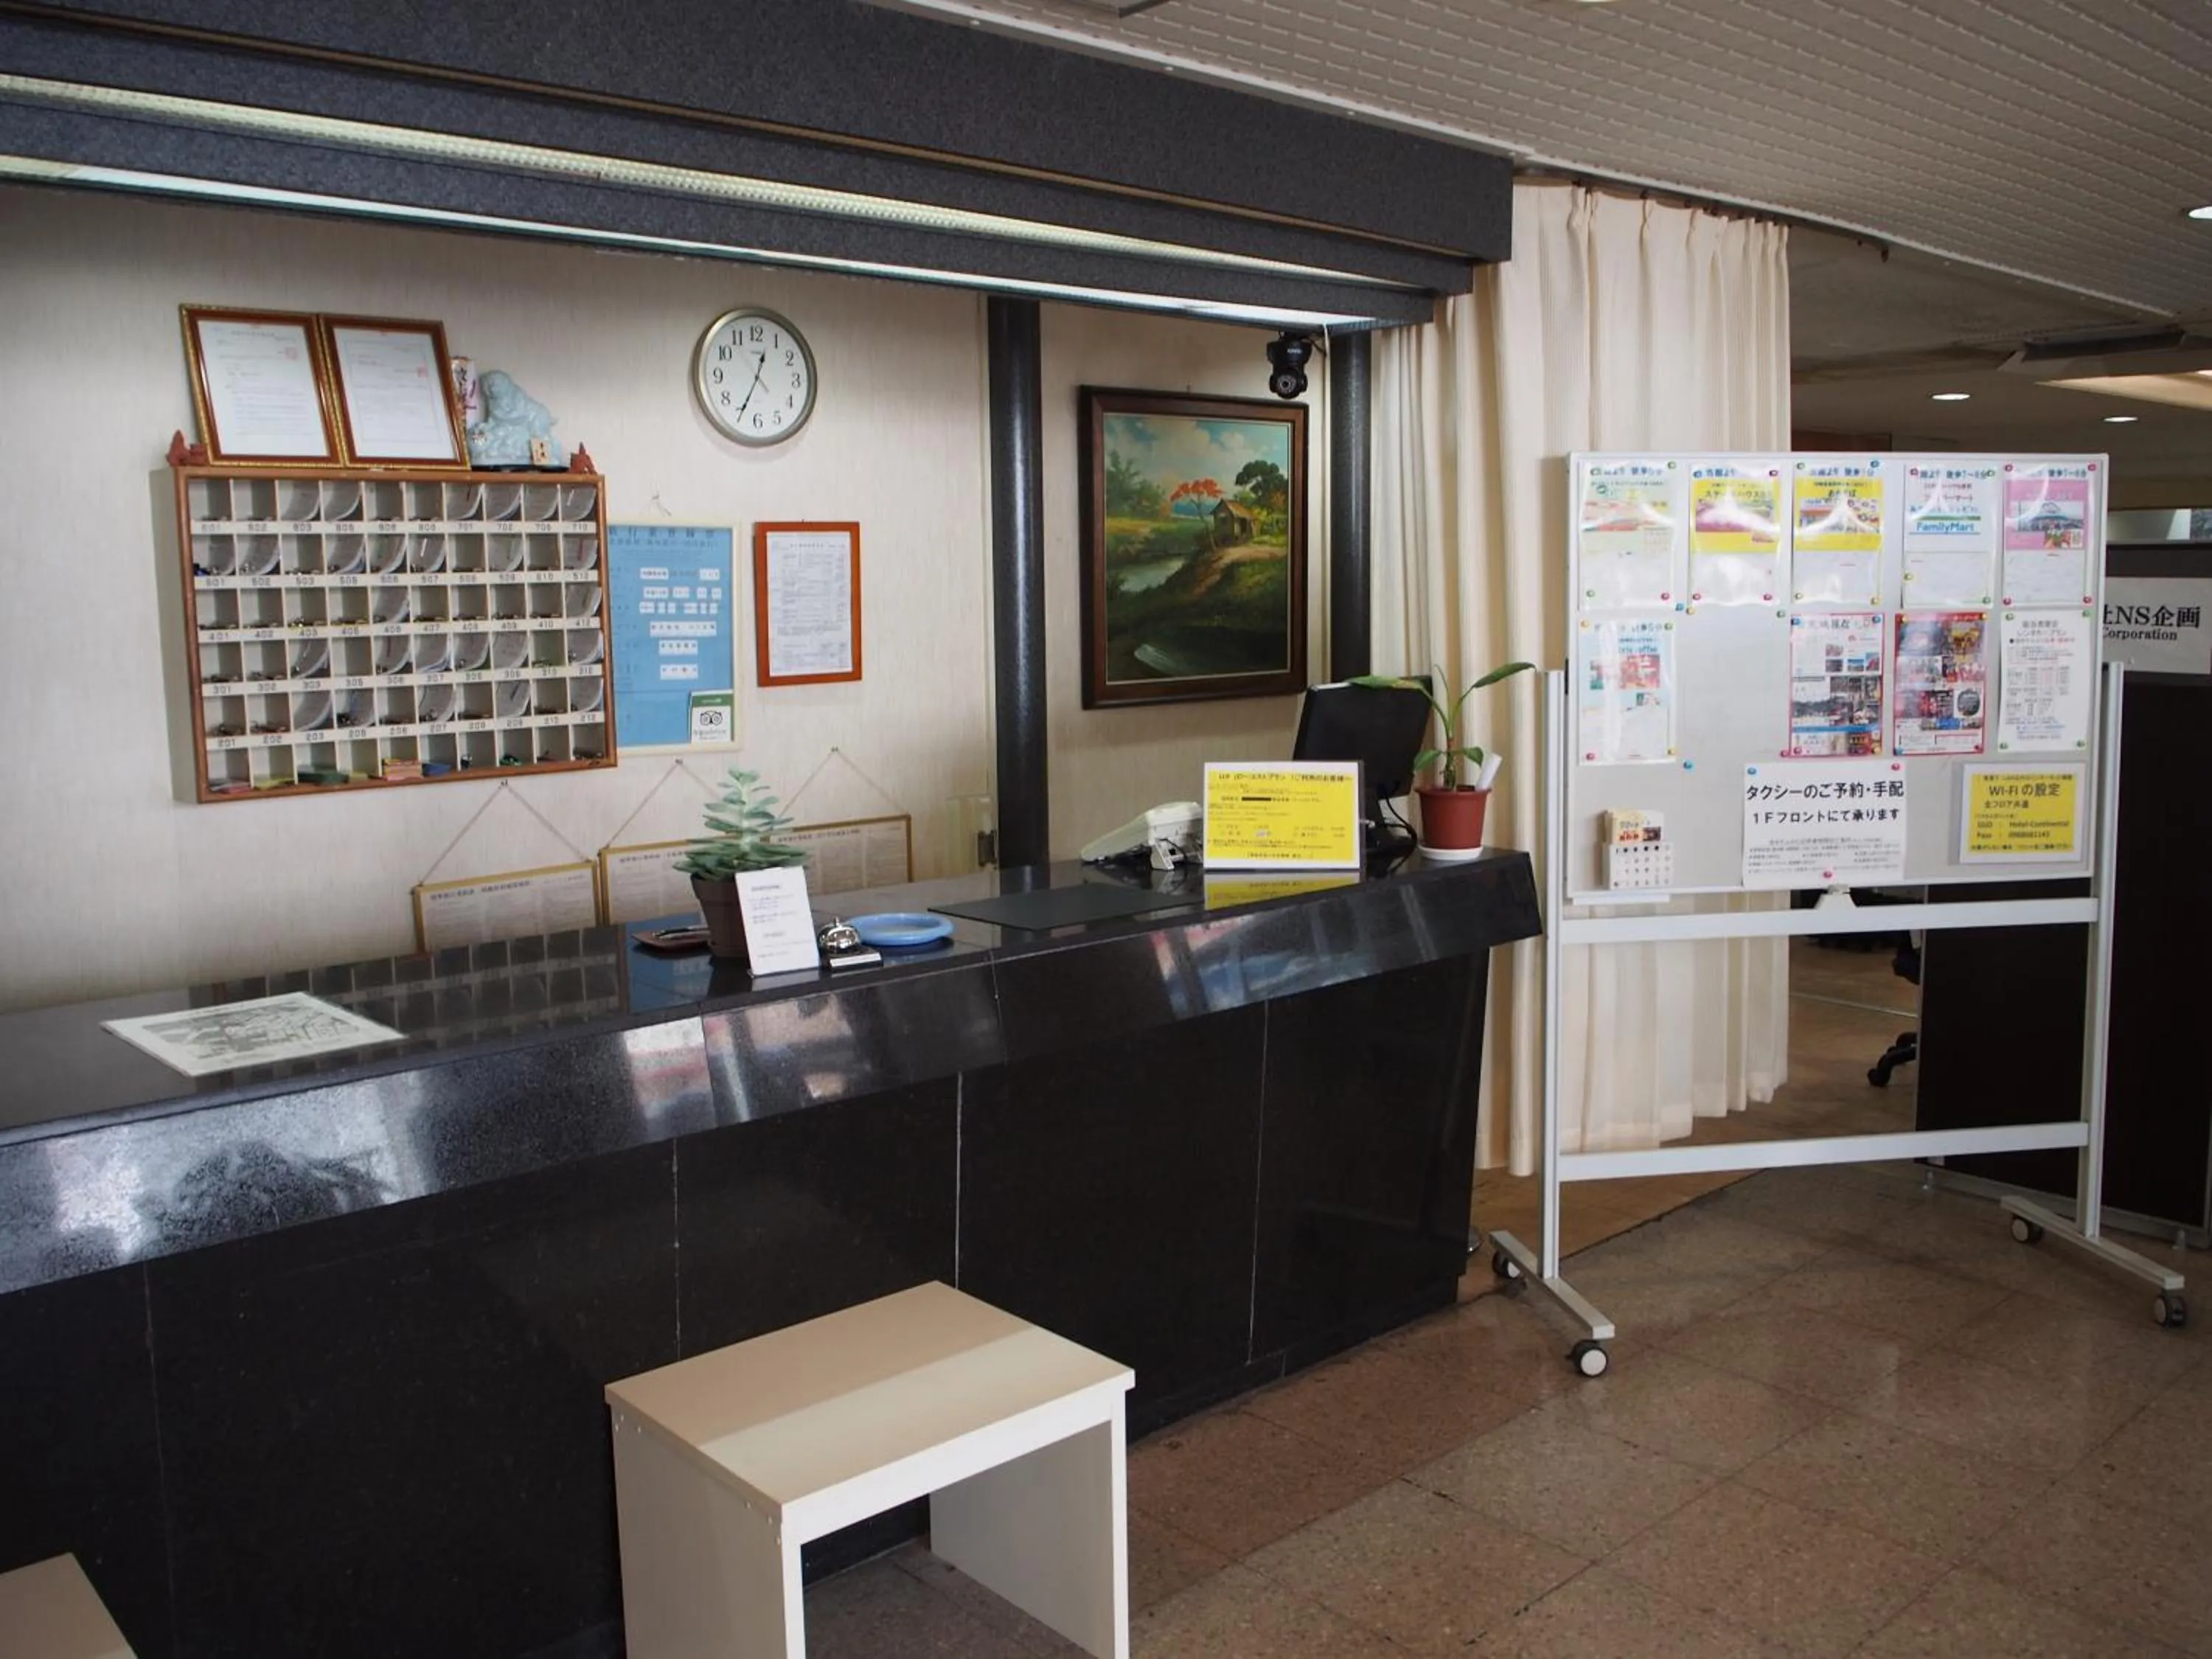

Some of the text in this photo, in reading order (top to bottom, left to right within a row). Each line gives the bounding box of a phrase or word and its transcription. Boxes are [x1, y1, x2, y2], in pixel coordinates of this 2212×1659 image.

[732, 330, 742, 346] 11
[750, 325, 763, 342] 12
[719, 345, 732, 361] 10
[785, 350, 794, 366] 2
[713, 367, 723, 384] 9
[791, 372, 801, 389] 3
[721, 391, 731, 406] 8
[786, 394, 793, 408] 4
[753, 414, 763, 428] 6
[773, 411, 781, 425] 5
[1916, 522, 1975, 532] FamilyMart
[1747, 780, 1905, 801] タクシーのご予約・手配
